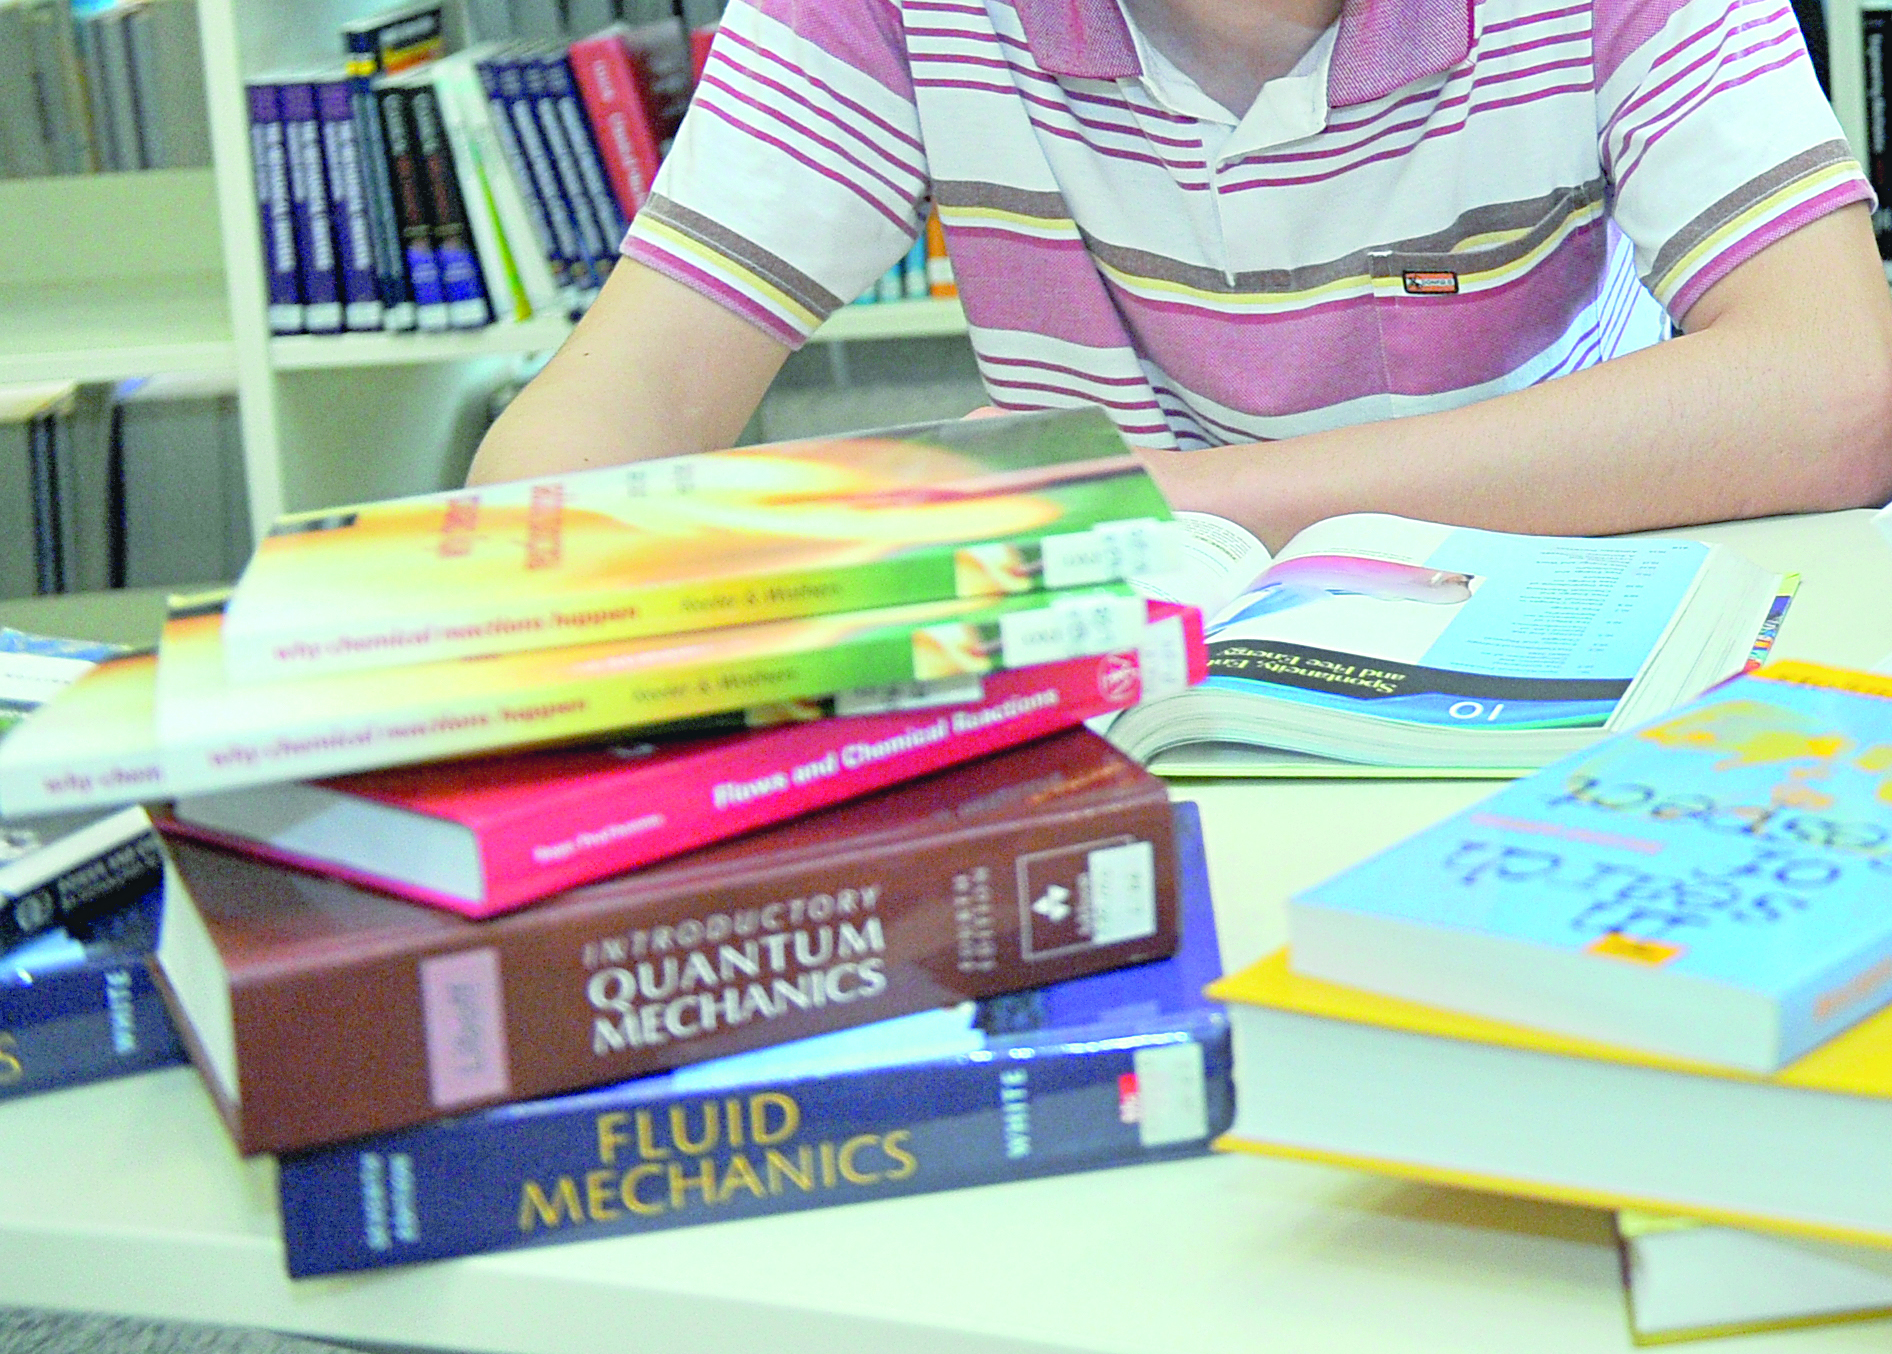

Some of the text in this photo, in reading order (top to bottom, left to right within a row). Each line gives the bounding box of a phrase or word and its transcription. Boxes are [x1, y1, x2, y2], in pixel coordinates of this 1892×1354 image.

[273, 639, 323, 665] why
[327, 623, 433, 657] chemical
[440, 612, 545, 644] reactions
[552, 600, 640, 631] happen
[1217, 646, 1406, 681] and Free Energy
[1205, 657, 1397, 694] Spontaneity, Ent
[1448, 700, 1505, 722] 10
[208, 742, 259, 769] why
[262, 726, 375, 760] chemical
[382, 714, 489, 743] reactions
[500, 698, 590, 731] happen
[711, 686, 1060, 811] Flows and Chemical Reactions
[43, 765, 161, 795] why chem
[583, 884, 884, 967] INTRODUCTORY
[586, 915, 887, 1015] QUANTUM
[104, 968, 136, 1054] WHITE
[591, 957, 889, 1057] MECHANICS
[598, 1092, 801, 1166] FLUID
[1001, 1067, 1031, 1159] WHITE
[518, 1129, 919, 1231] MECHANICS
